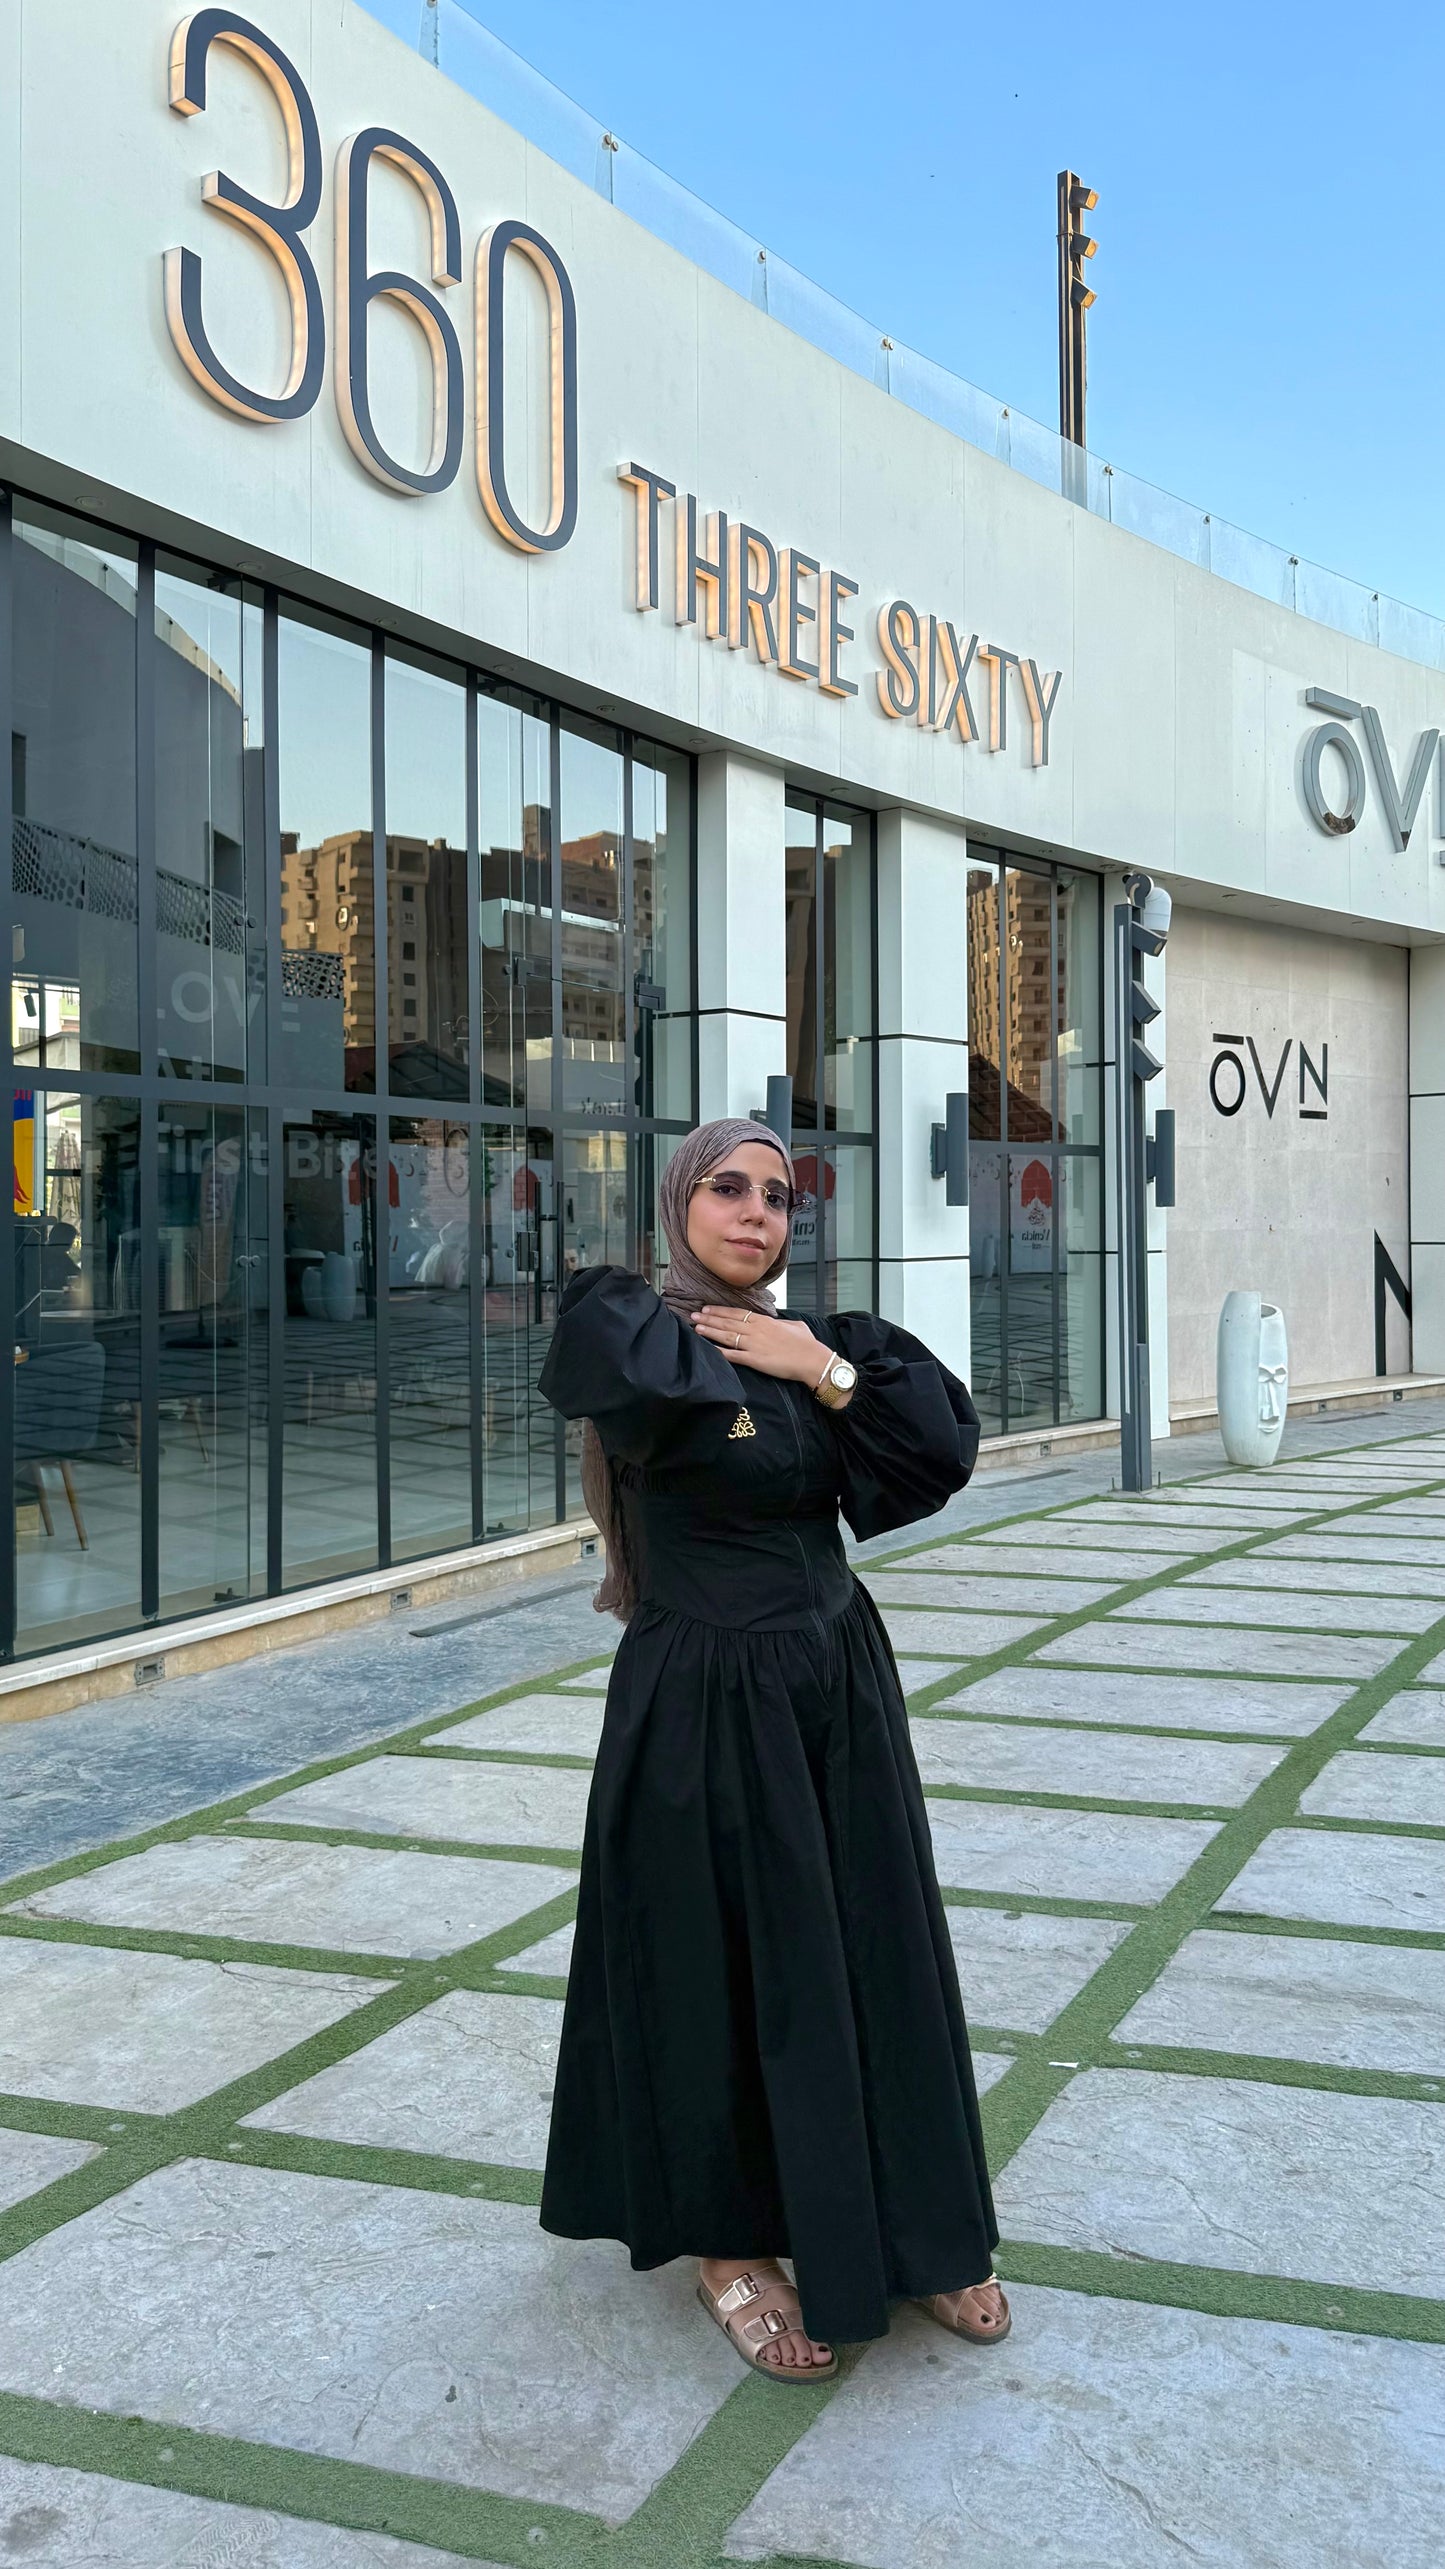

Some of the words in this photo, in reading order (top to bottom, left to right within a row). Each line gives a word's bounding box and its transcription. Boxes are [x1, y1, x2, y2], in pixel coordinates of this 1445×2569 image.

[164, 8, 578, 554] 360
[617, 461, 859, 698] THREE
[876, 600, 1063, 768] SIXTY
